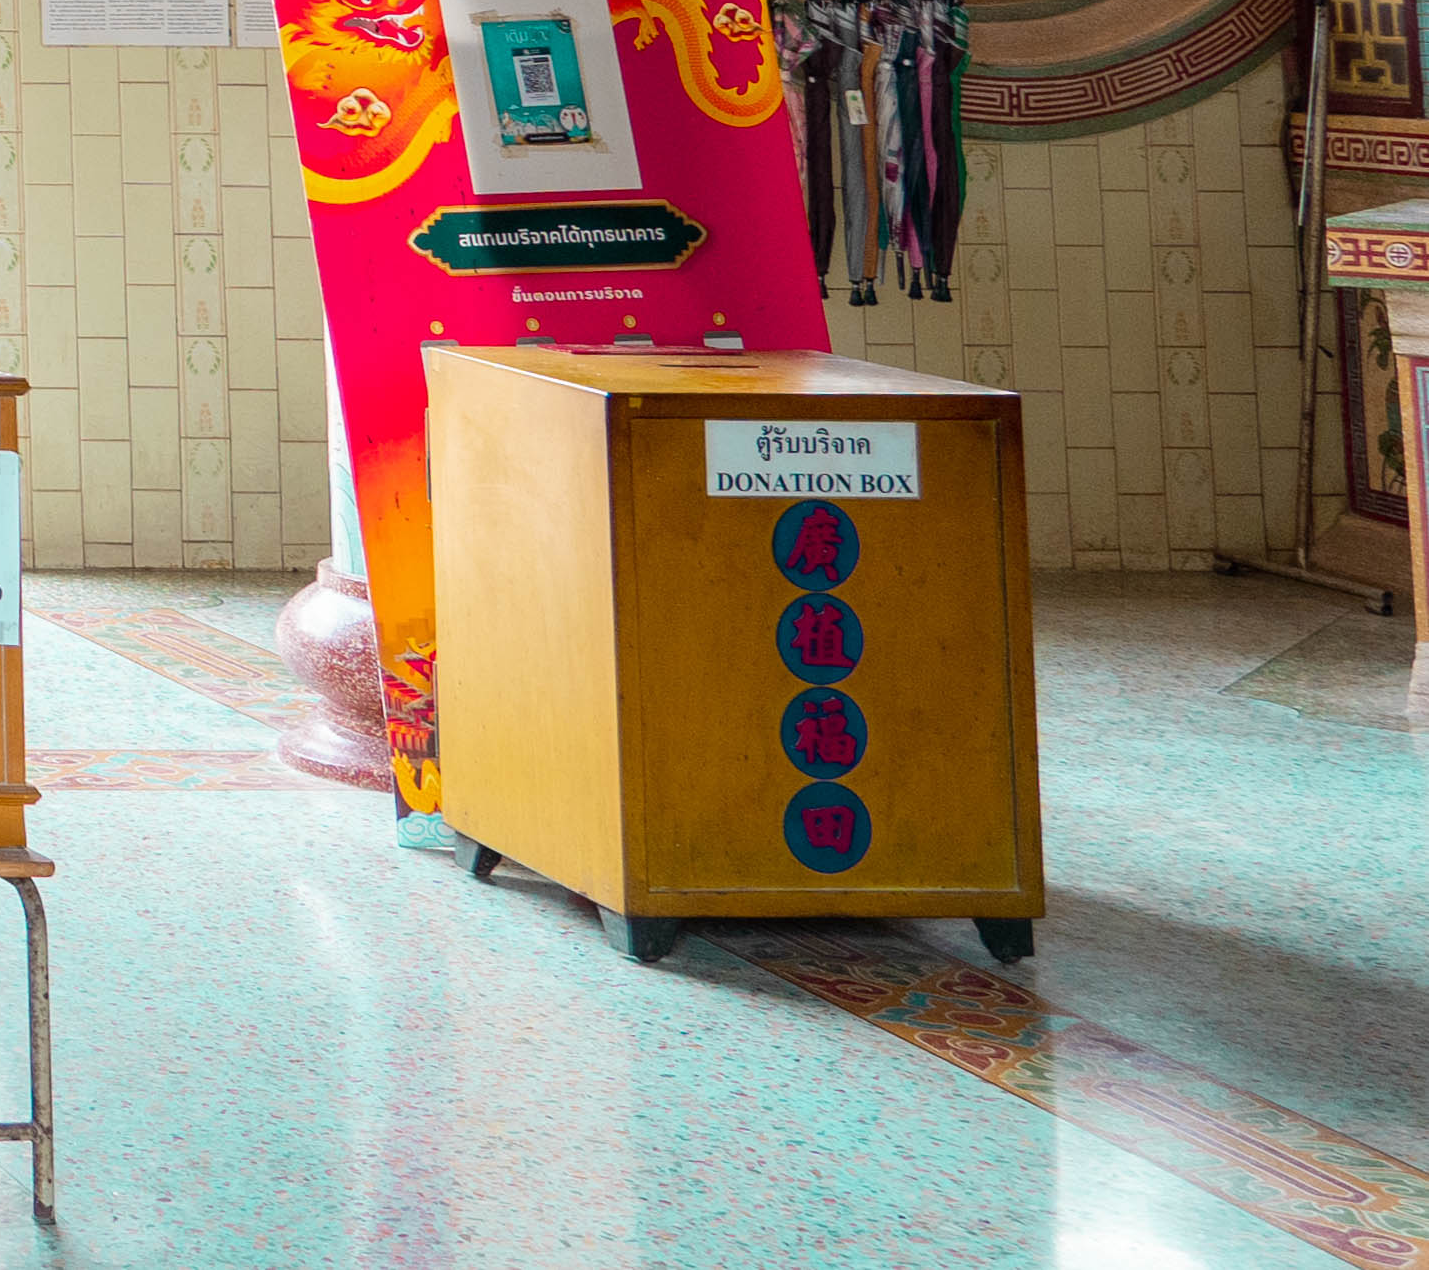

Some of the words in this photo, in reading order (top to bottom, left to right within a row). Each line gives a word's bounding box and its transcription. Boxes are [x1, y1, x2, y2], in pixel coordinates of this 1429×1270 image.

[459, 224, 666, 249] สแกนบริจาคได้ทุกธนาคาร
[511, 285, 644, 303] ขั้นตอนการบริจาค
[756, 425, 871, 461] ตู้รับบริจาค
[717, 472, 852, 492] DONATION
[859, 474, 913, 494] BOX
